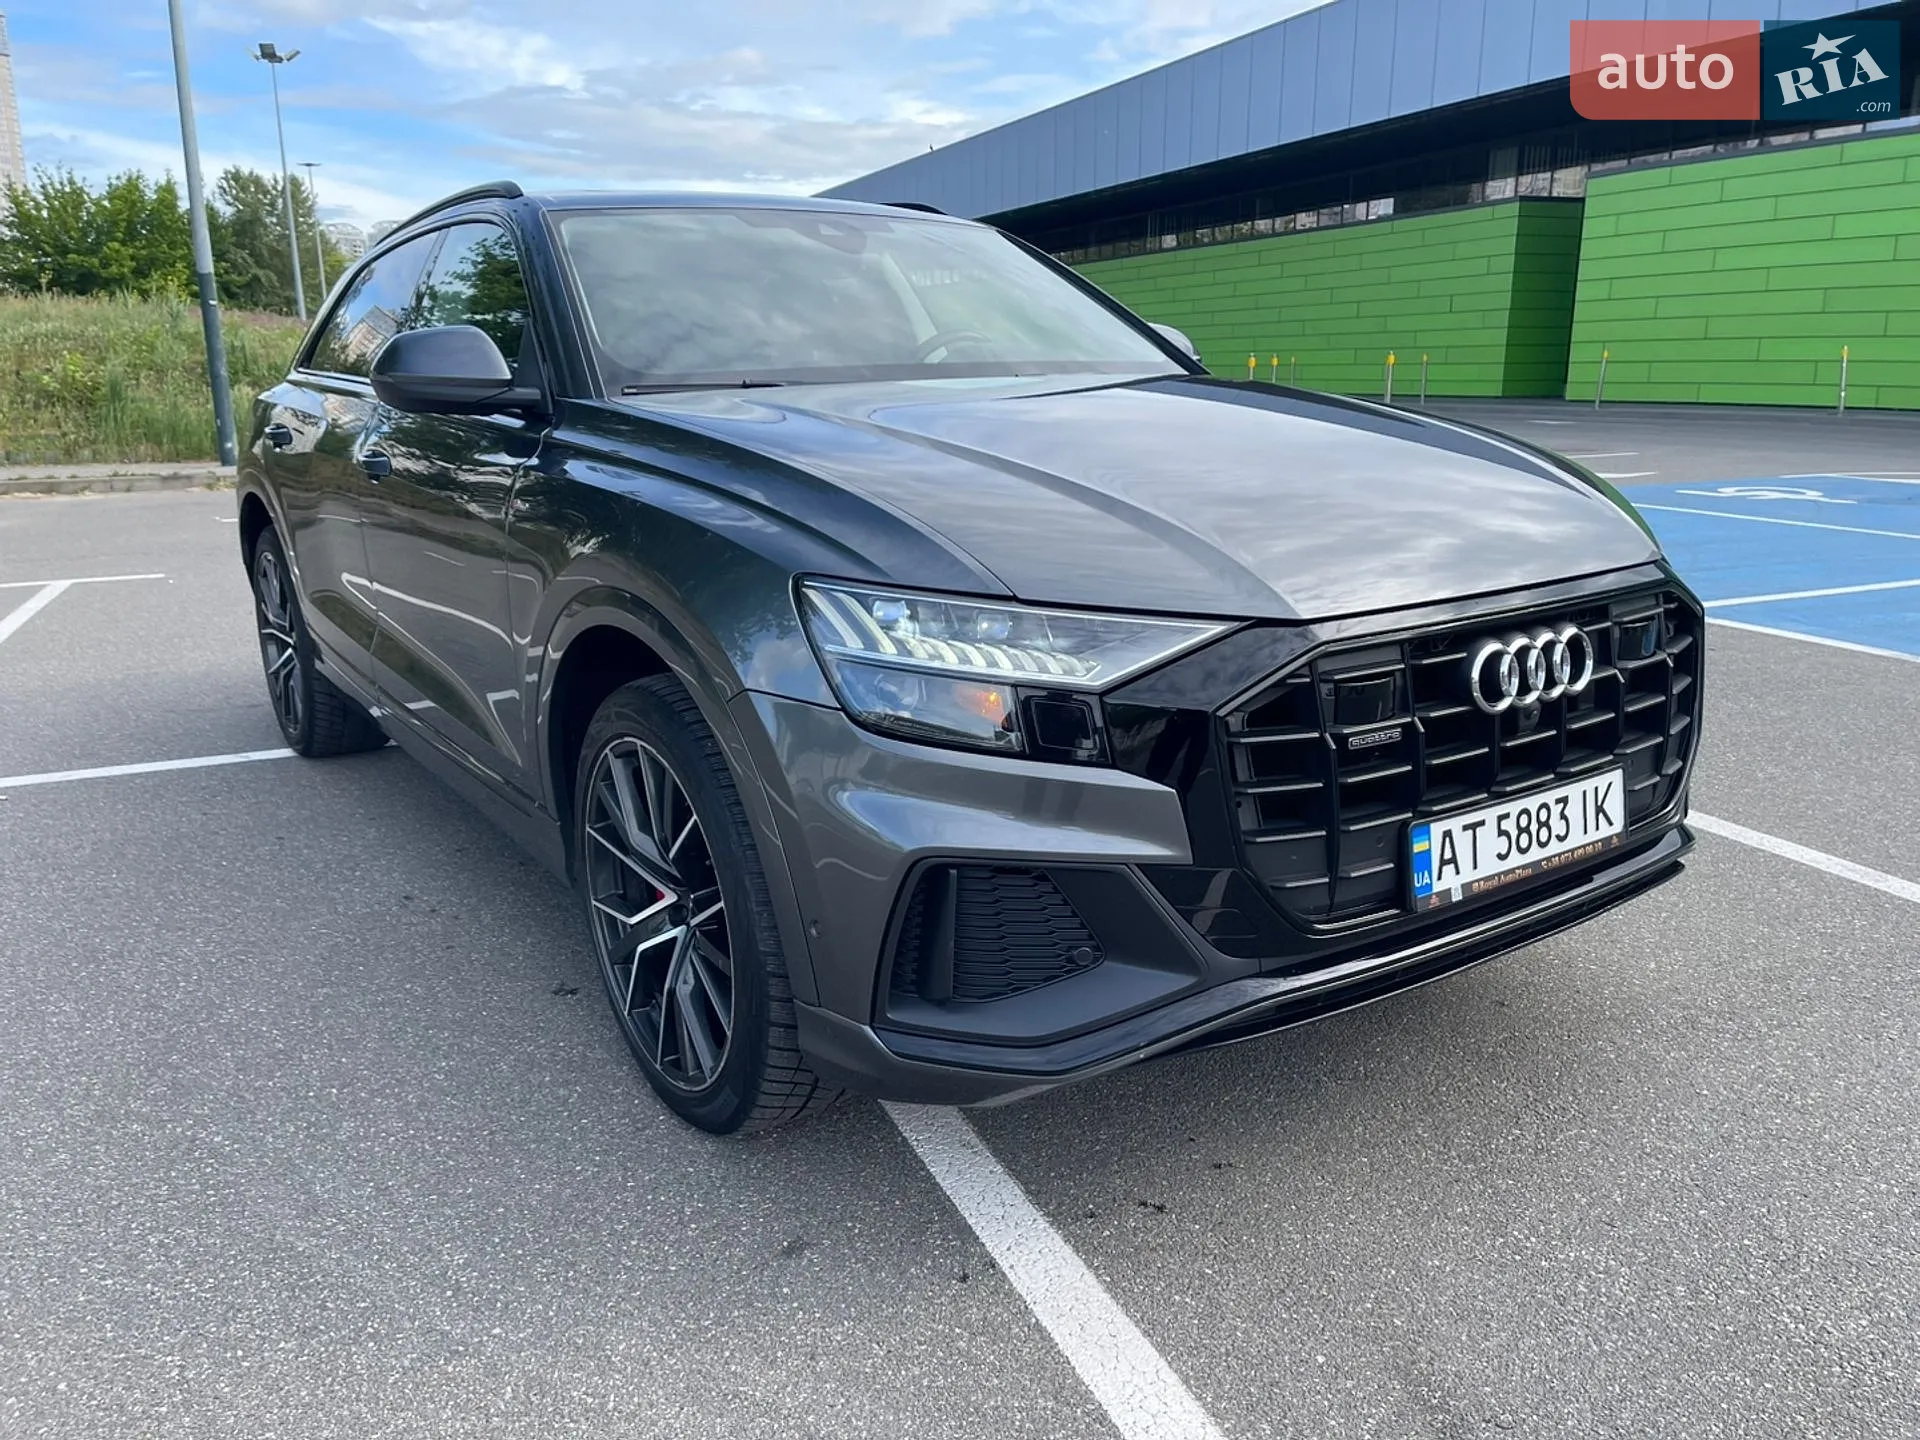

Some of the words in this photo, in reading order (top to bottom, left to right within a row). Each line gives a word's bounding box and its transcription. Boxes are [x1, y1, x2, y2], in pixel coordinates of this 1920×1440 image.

[1352, 731, 1401, 747] quattro
[1437, 819, 1486, 881] AT
[1496, 795, 1570, 862] 5883
[1582, 781, 1615, 835] IK
[1414, 871, 1431, 887] UA
